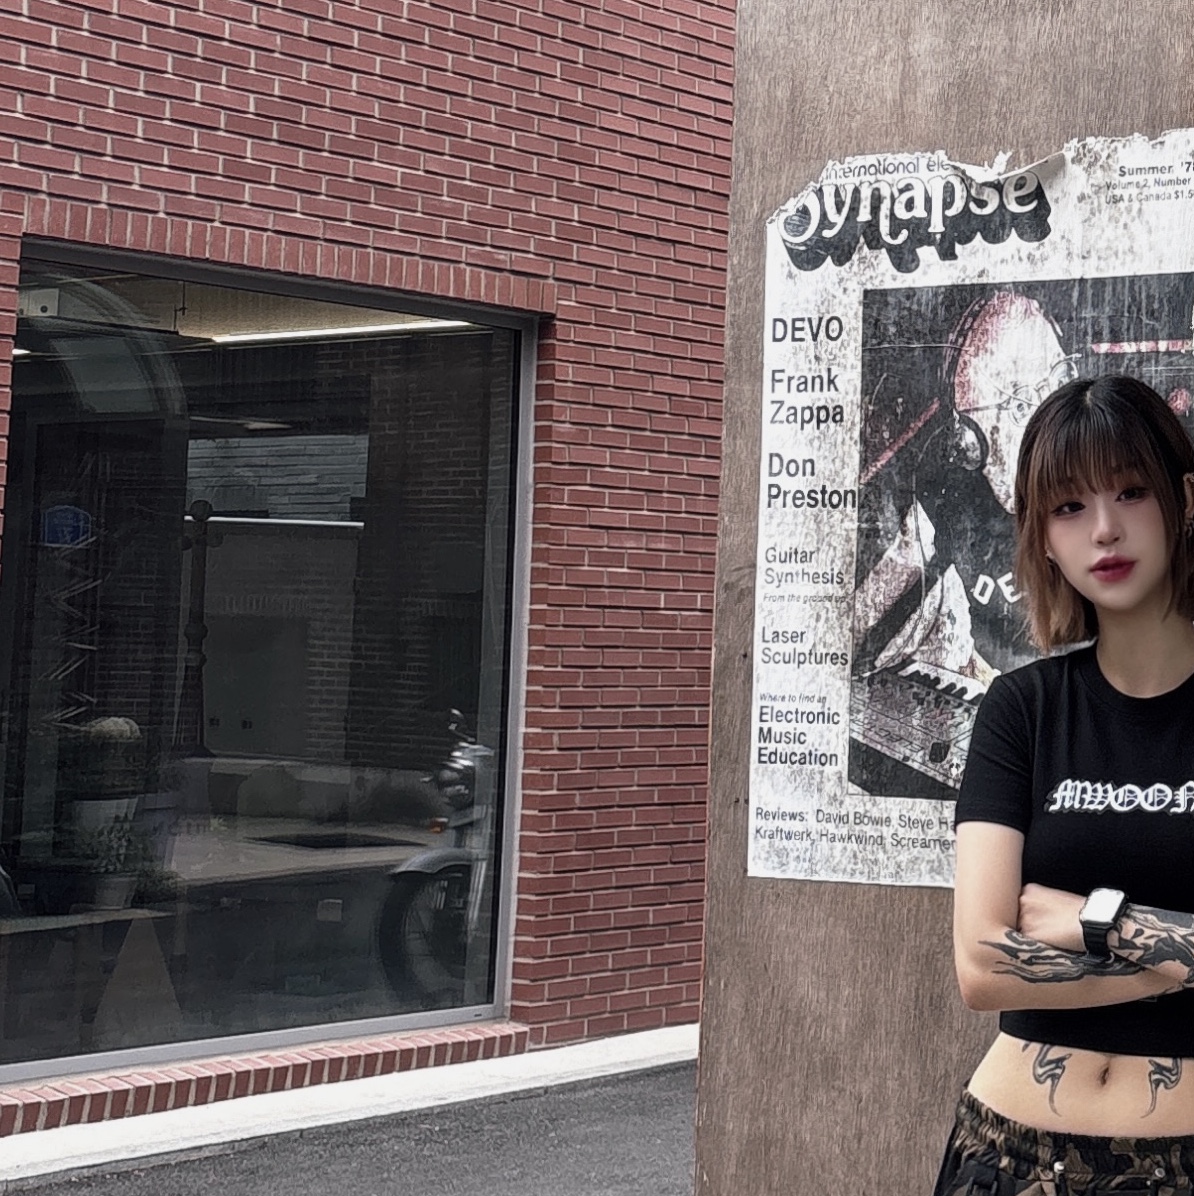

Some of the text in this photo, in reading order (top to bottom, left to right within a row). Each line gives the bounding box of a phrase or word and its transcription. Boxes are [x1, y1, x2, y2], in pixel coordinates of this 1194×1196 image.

[1118, 165, 1174, 177] Summer
[1105, 179, 1140, 191] Volume
[1153, 176, 1192, 187] Number
[1105, 193, 1125, 205] USA
[1136, 191, 1172, 202] Canada
[771, 315, 844, 343] DEVO
[771, 367, 839, 394] Frank
[769, 400, 845, 430] Zappa
[768, 452, 816, 477] Don
[767, 483, 857, 509] Preston
[764, 546, 816, 564] Guitar
[764, 567, 844, 588] Synthesis
[763, 592, 785, 602] From
[787, 593, 801, 602] the
[761, 626, 807, 643] Laser
[761, 647, 848, 668] Sculptures
[760, 692, 786, 702] Where
[788, 693, 797, 703] to
[798, 692, 816, 703] find
[758, 705, 841, 725] Electronic
[757, 726, 807, 745] Music
[757, 746, 838, 767] Education
[755, 806, 809, 823] Reviews:
[815, 808, 850, 825] David
[898, 813, 934, 832] Steve
[755, 827, 816, 845] Kraftwerk,
